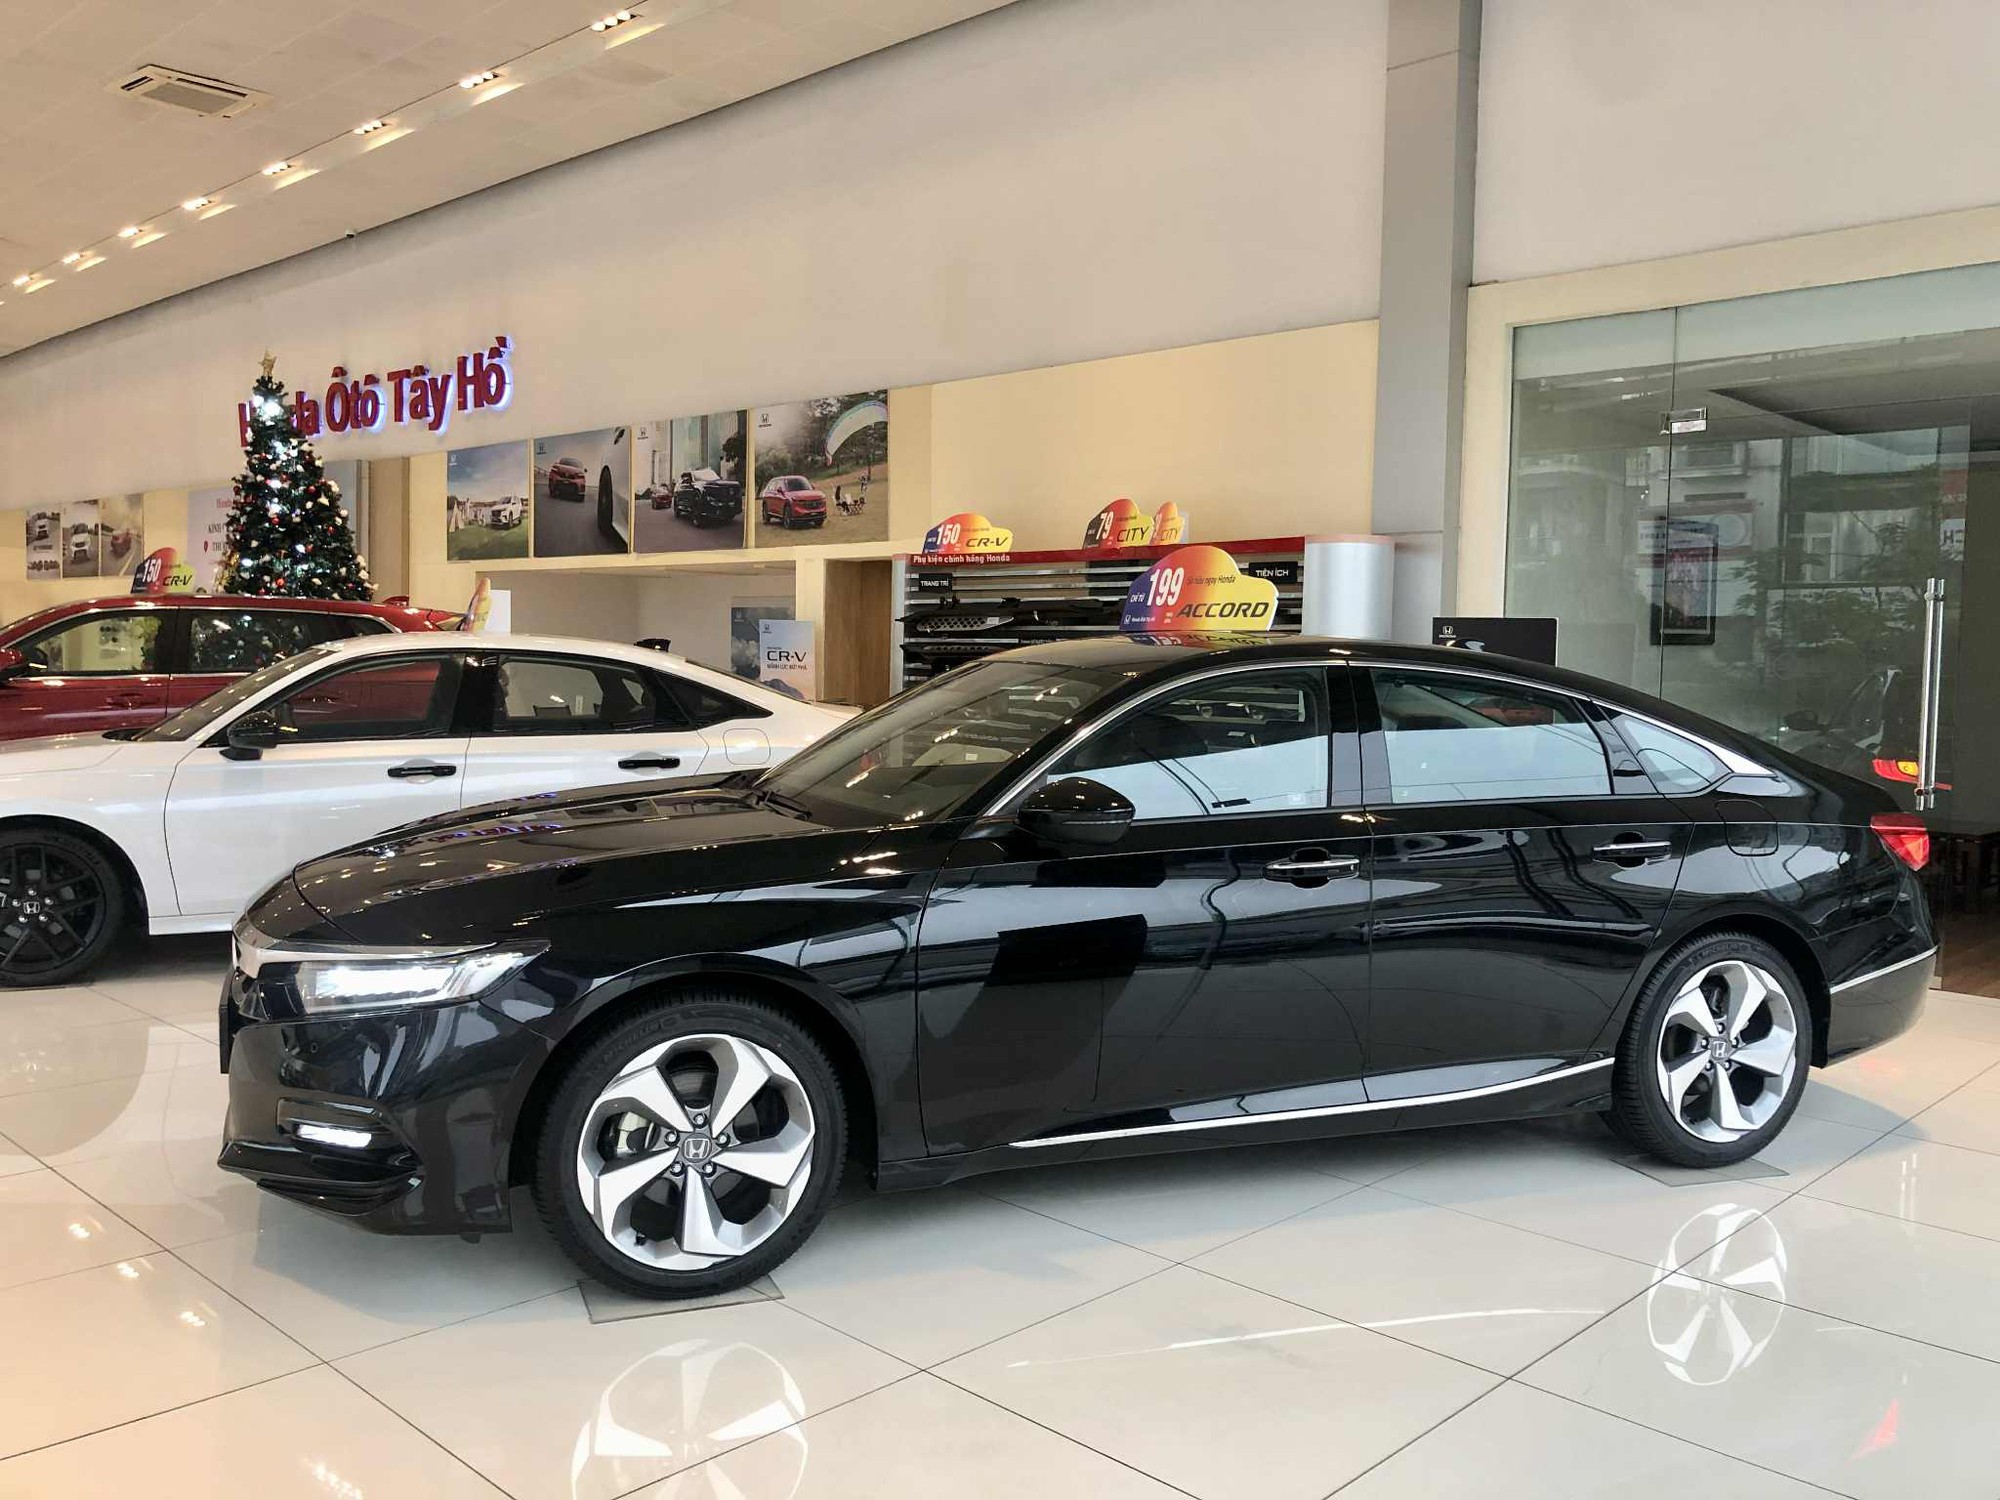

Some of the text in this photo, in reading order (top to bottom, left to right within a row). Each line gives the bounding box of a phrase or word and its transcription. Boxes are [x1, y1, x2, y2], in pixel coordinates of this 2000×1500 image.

[387, 364, 452, 431] Tây
[457, 336, 509, 411] Hồ
[1096, 511, 1114, 540] 79
[936, 523, 961, 545] 150
[1117, 526, 1149, 542] CITY
[965, 537, 1008, 548] CR-V
[986, 554, 1010, 562] Honda
[142, 558, 162, 583] 150
[163, 575, 193, 587] CR-V
[1147, 567, 1185, 606] 199
[1177, 602, 1269, 618] ACCORD
[767, 650, 807, 662] CR-V
